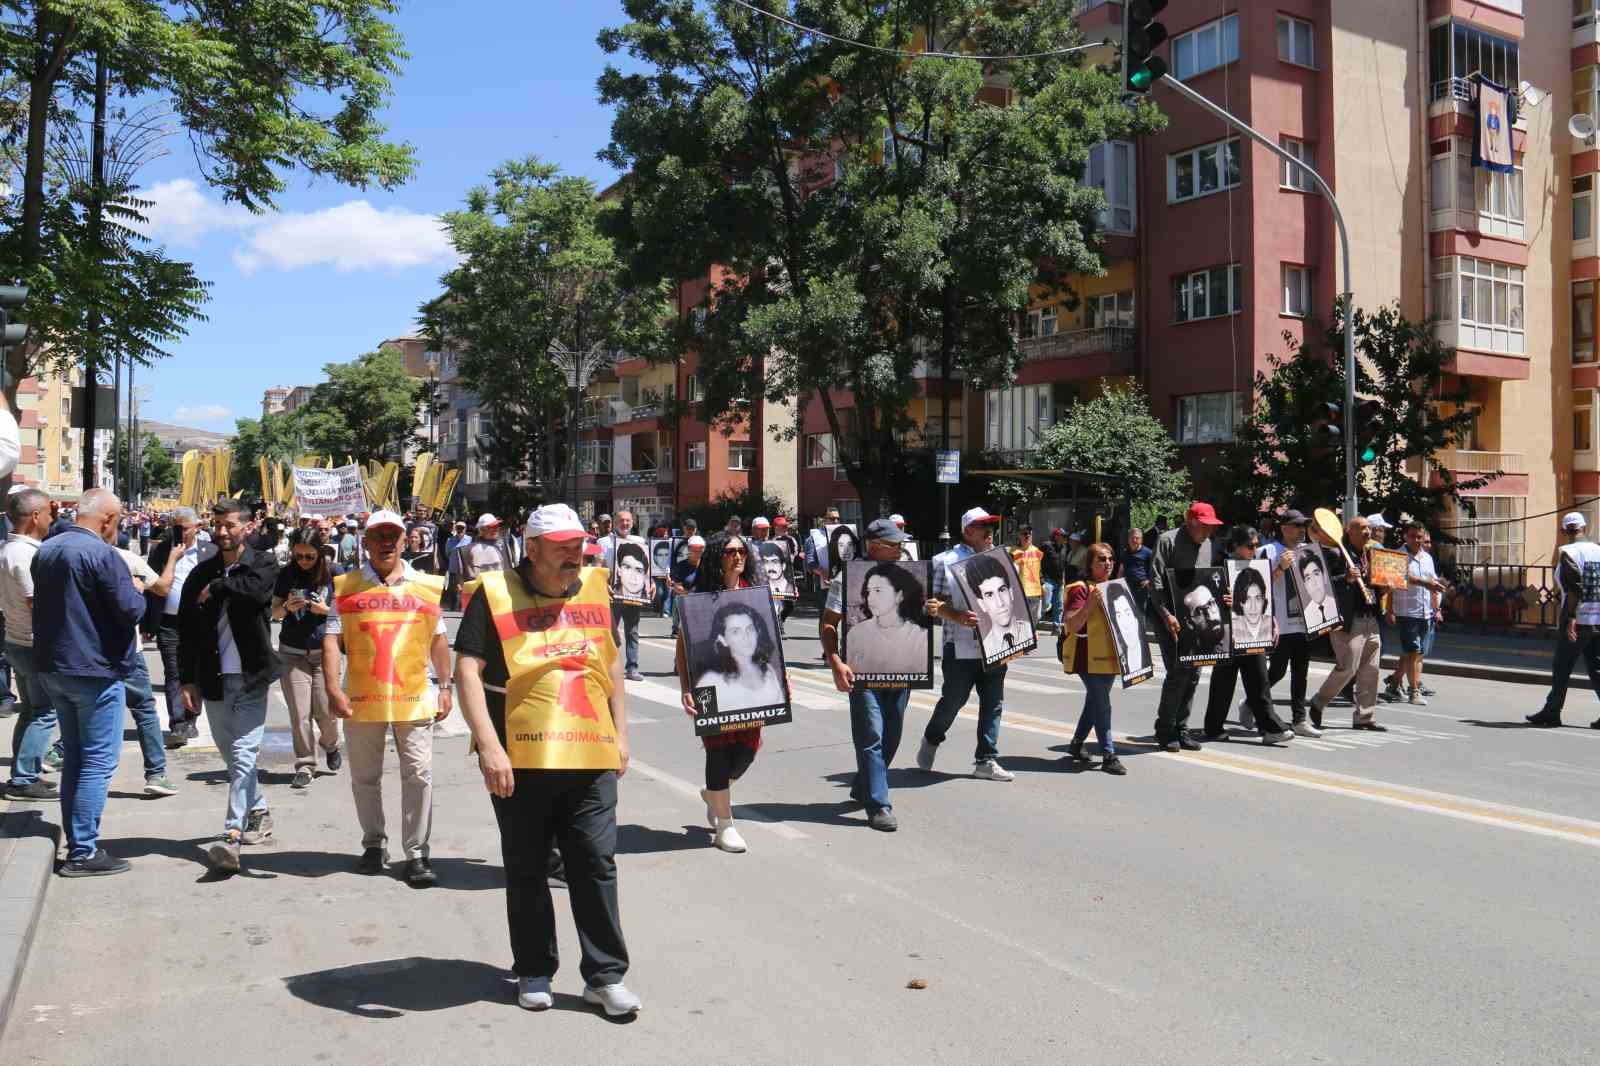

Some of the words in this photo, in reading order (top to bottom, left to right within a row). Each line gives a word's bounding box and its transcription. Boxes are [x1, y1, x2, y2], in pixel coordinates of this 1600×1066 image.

[1179, 652, 1231, 662] ONURUMUZ
[853, 673, 930, 682] NURUMUZ
[696, 707, 787, 727] ONURUMUZ
